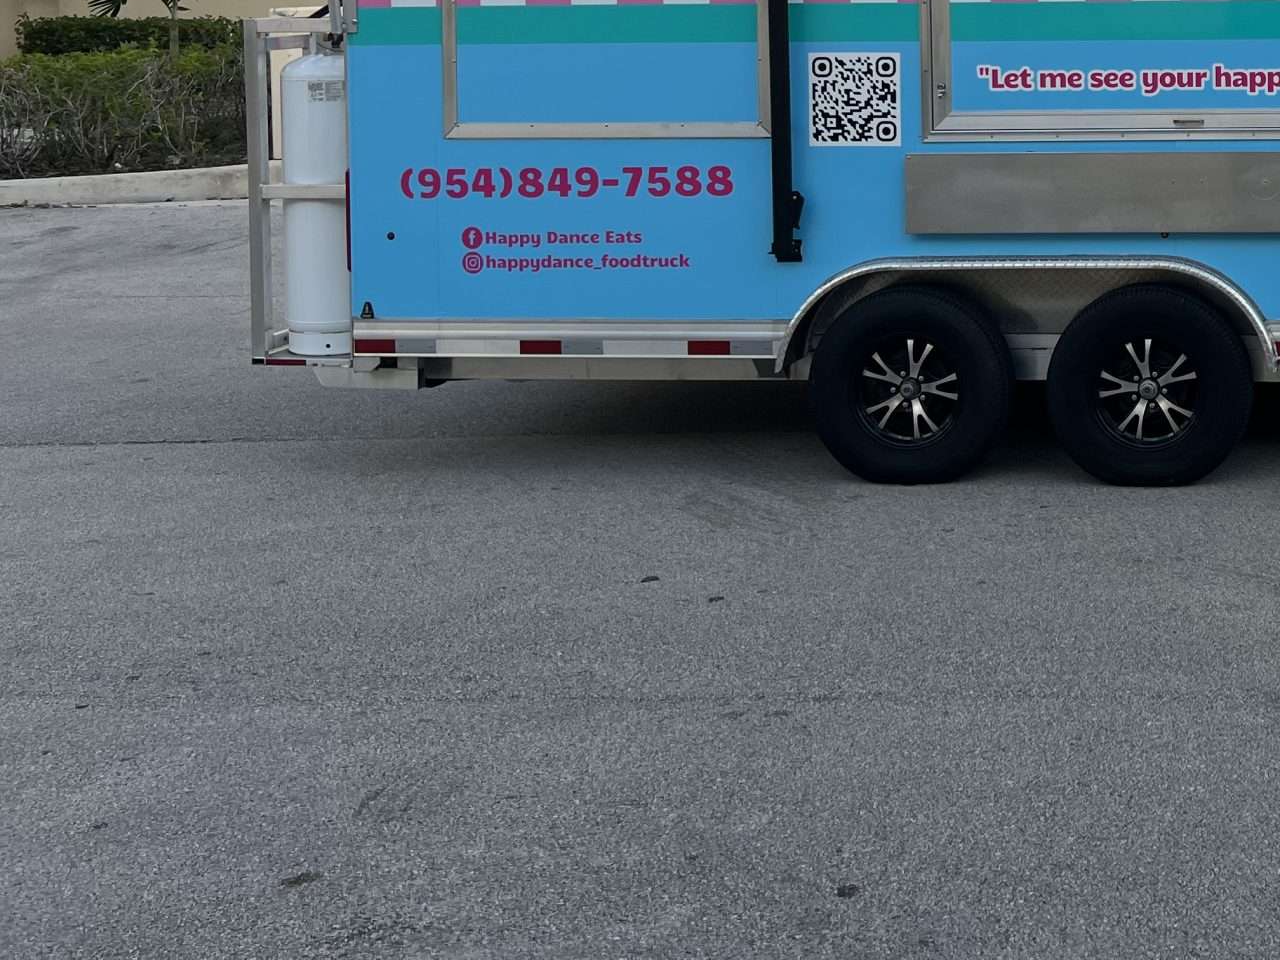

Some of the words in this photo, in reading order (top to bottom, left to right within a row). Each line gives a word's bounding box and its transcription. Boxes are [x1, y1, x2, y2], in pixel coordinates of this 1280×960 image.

[977, 66, 1032, 90] "Let
[1038, 71, 1083, 89] me
[1090, 71, 1134, 89] see
[1141, 69, 1208, 94] your
[400, 165, 735, 199] (954)849-7588
[485, 231, 541, 248] Happy
[546, 231, 600, 244] Dance
[605, 230, 642, 244] Eats
[486, 254, 690, 272] happydance_foodtruck
